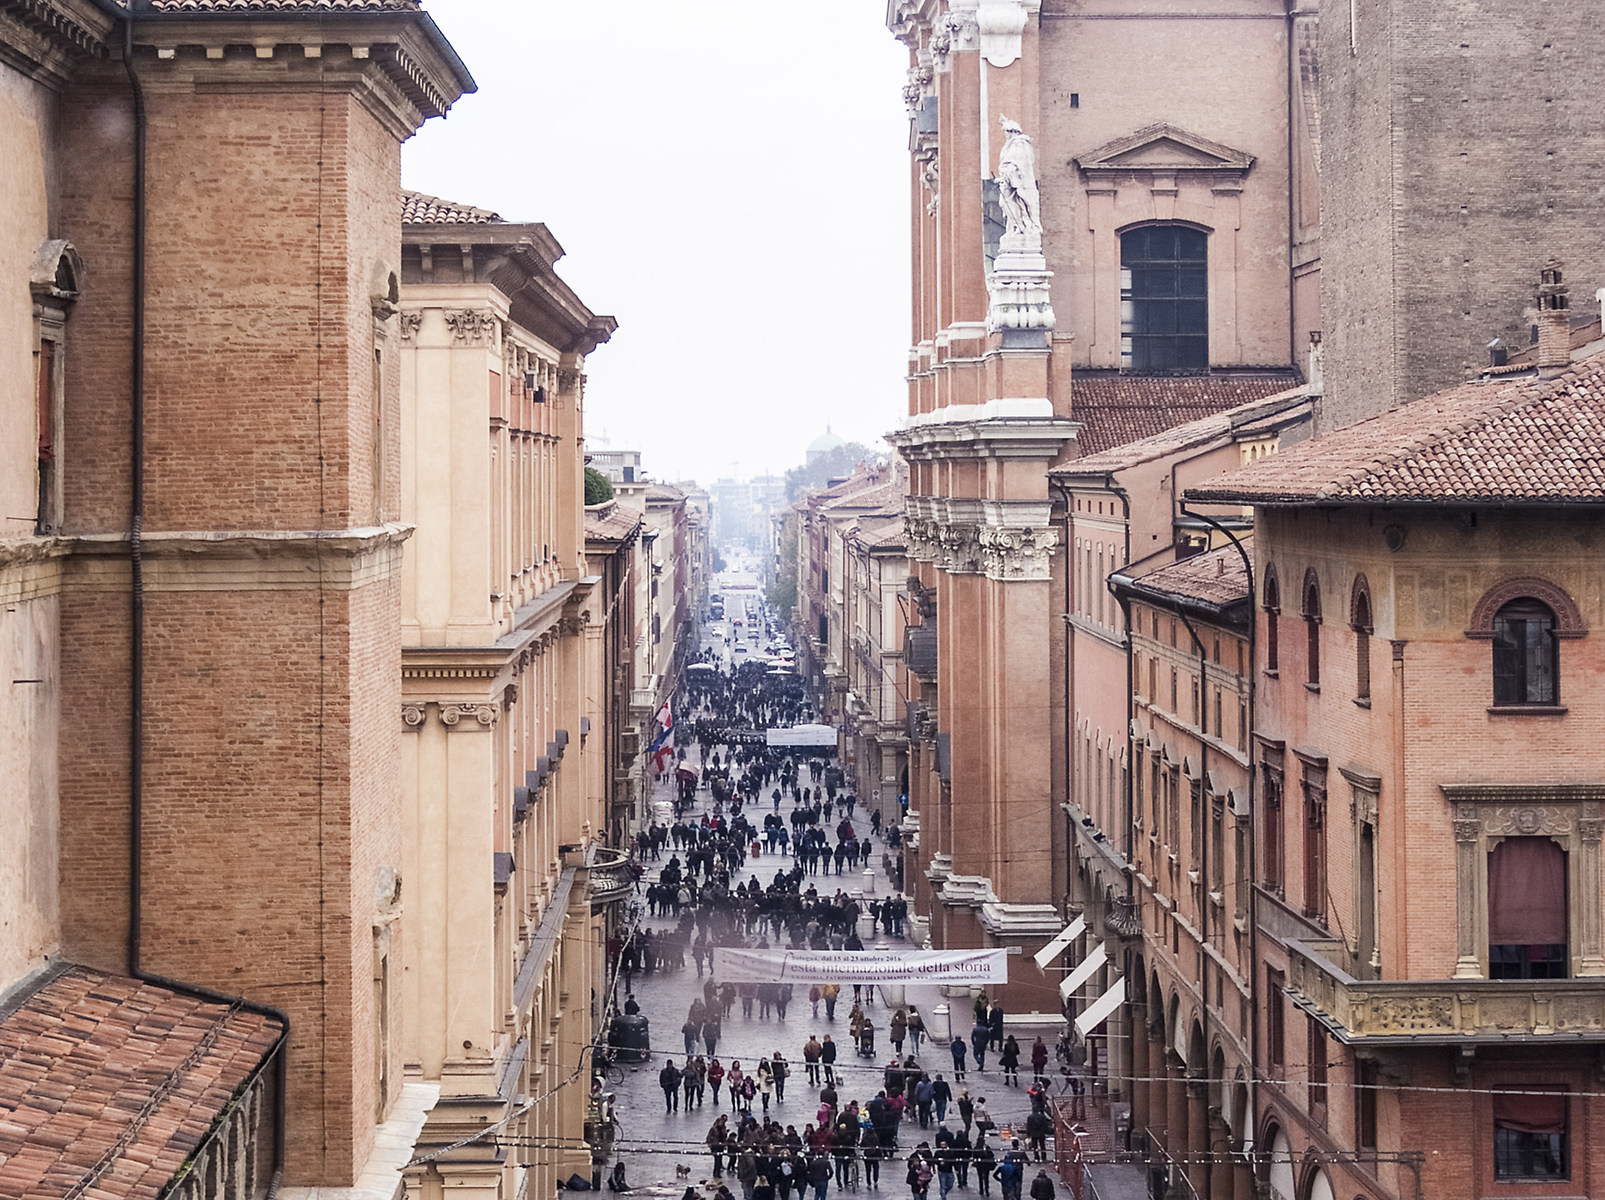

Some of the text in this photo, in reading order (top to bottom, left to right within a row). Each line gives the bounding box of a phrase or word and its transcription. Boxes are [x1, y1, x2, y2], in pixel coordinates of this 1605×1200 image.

[822, 962, 915, 974] internazionale
[918, 961, 951, 973] della
[954, 961, 991, 973] storia
